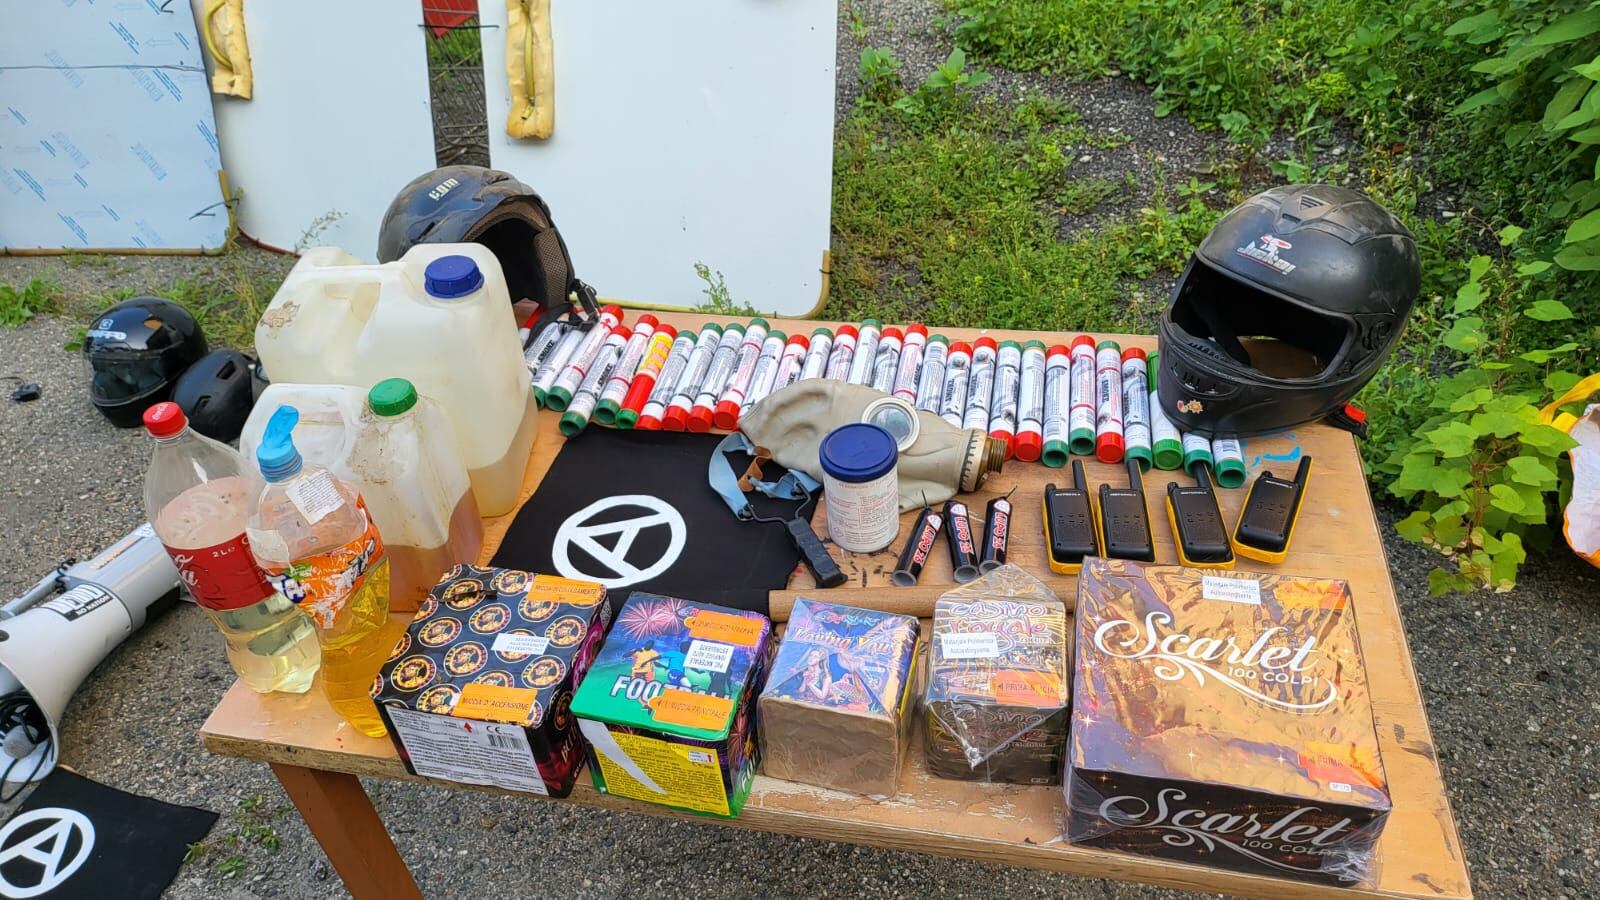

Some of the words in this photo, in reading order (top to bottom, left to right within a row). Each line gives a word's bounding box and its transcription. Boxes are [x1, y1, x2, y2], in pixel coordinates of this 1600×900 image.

[918, 525, 936, 552] LUPO
[1094, 611, 1320, 672] Scarlet
[1228, 666, 1257, 679] 100
[1263, 672, 1319, 686] COLPI
[1099, 788, 1351, 847] Scarlet
[1242, 838, 1272, 850] 100
